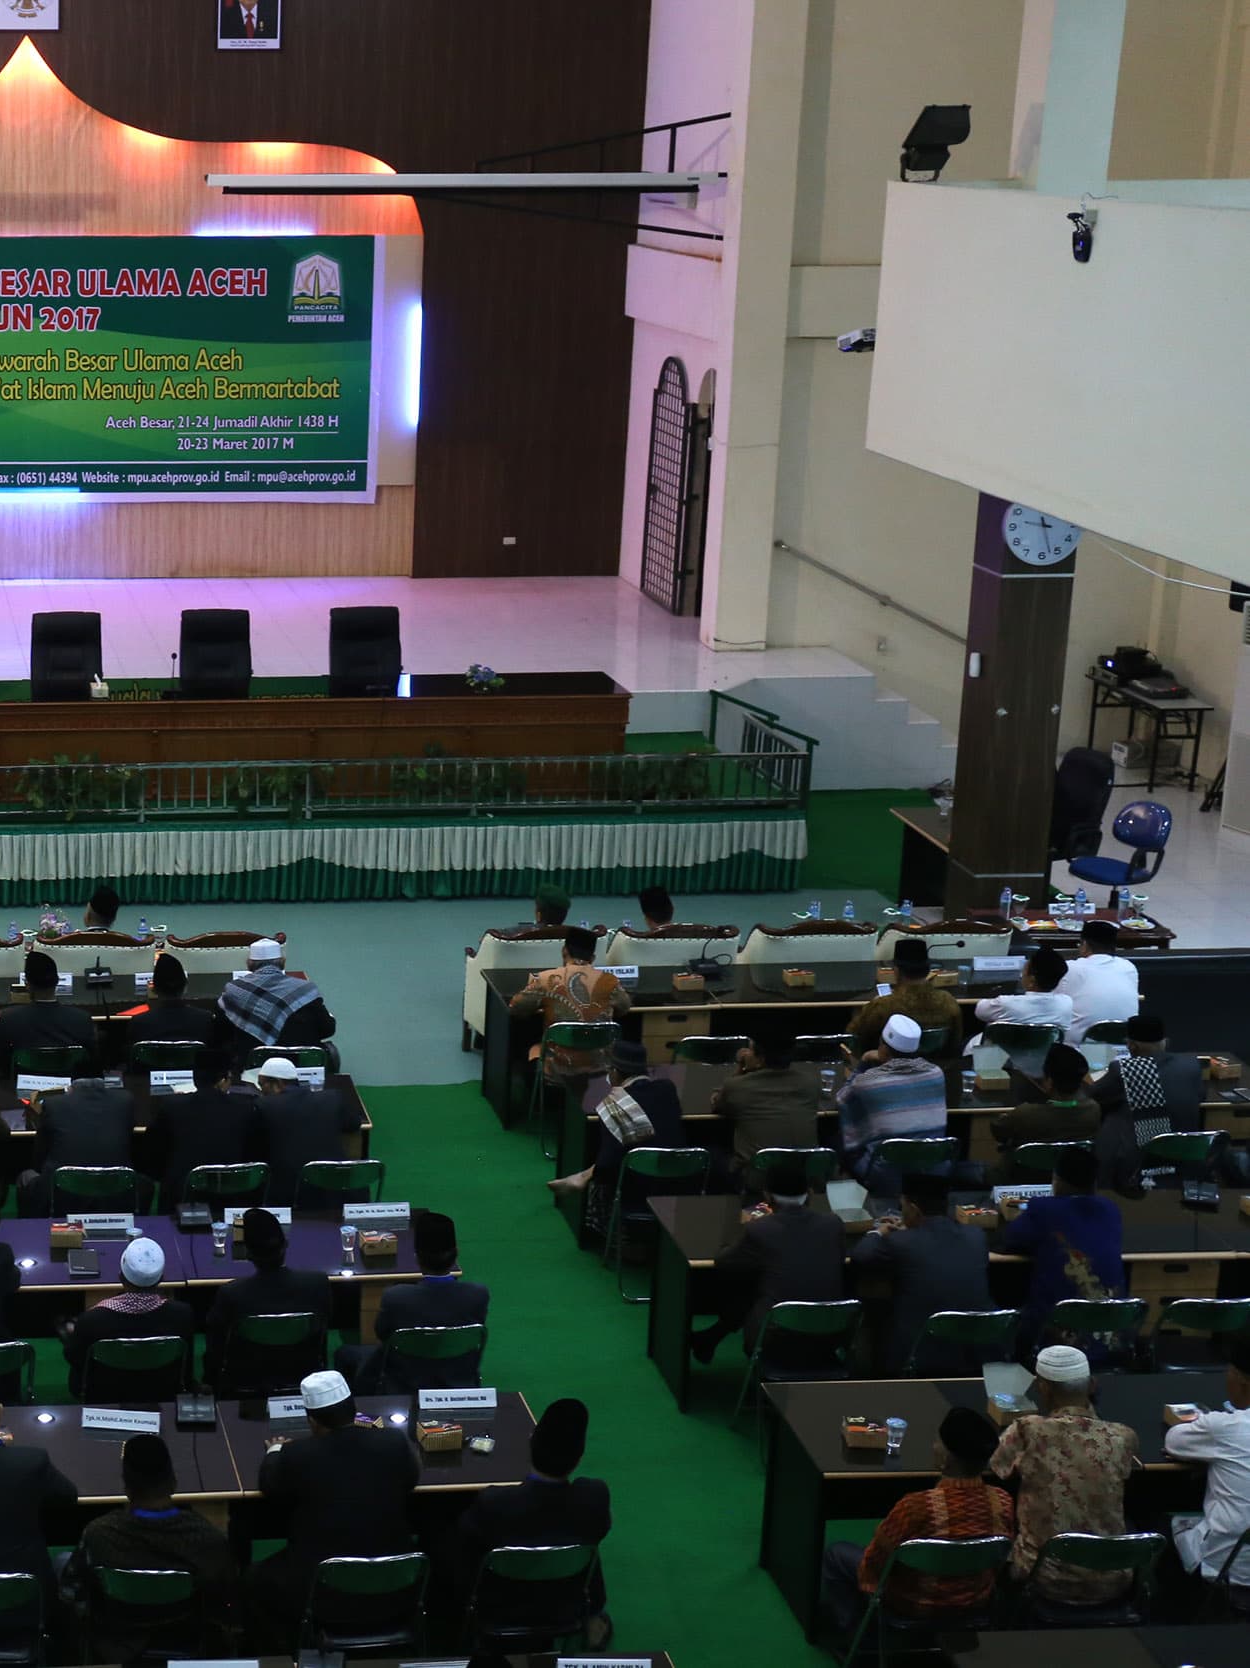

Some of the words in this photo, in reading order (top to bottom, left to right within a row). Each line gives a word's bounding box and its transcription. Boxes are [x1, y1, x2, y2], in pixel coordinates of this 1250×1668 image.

[77, 268, 184, 297] ULAMA
[187, 268, 268, 296] ACEH
[39, 306, 101, 331] 2017
[327, 314, 344, 322] ACEH
[65, 350, 118, 372] Besar
[123, 349, 189, 372] Ulama
[194, 349, 243, 371] Aceh
[27, 378, 77, 401] Islam
[82, 377, 155, 403] Menuju
[160, 377, 209, 400] Aceh
[213, 376, 340, 399] Bermartabat
[105, 416, 136, 429] Aceh
[139, 416, 175, 430] Besar,
[177, 416, 209, 429] 21-24
[213, 415, 257, 431] Jumadil
[260, 416, 293, 429] Akhir
[297, 415, 325, 428] 1438
[328, 415, 339, 428] H
[177, 437, 209, 450] 20-23
[213, 437, 247, 450] Maret
[250, 437, 280, 450] 2017
[283, 437, 294, 449] M
[16, 472, 46, 485] (0651)
[49, 472, 78, 484] 44394
[81, 472, 119, 484] Website
[127, 471, 220, 486] mpu.acehprov.go.id
[224, 471, 250, 483] Email
[257, 470, 356, 485] mpu@acehprov.go.id
[1009, 522, 1017, 531] 9
[1013, 537, 1021, 546] 8
[1064, 534, 1072, 542] 4
[1022, 548, 1030, 557] 7
[1037, 551, 1046, 560] 6
[1053, 546, 1062, 555] 5
